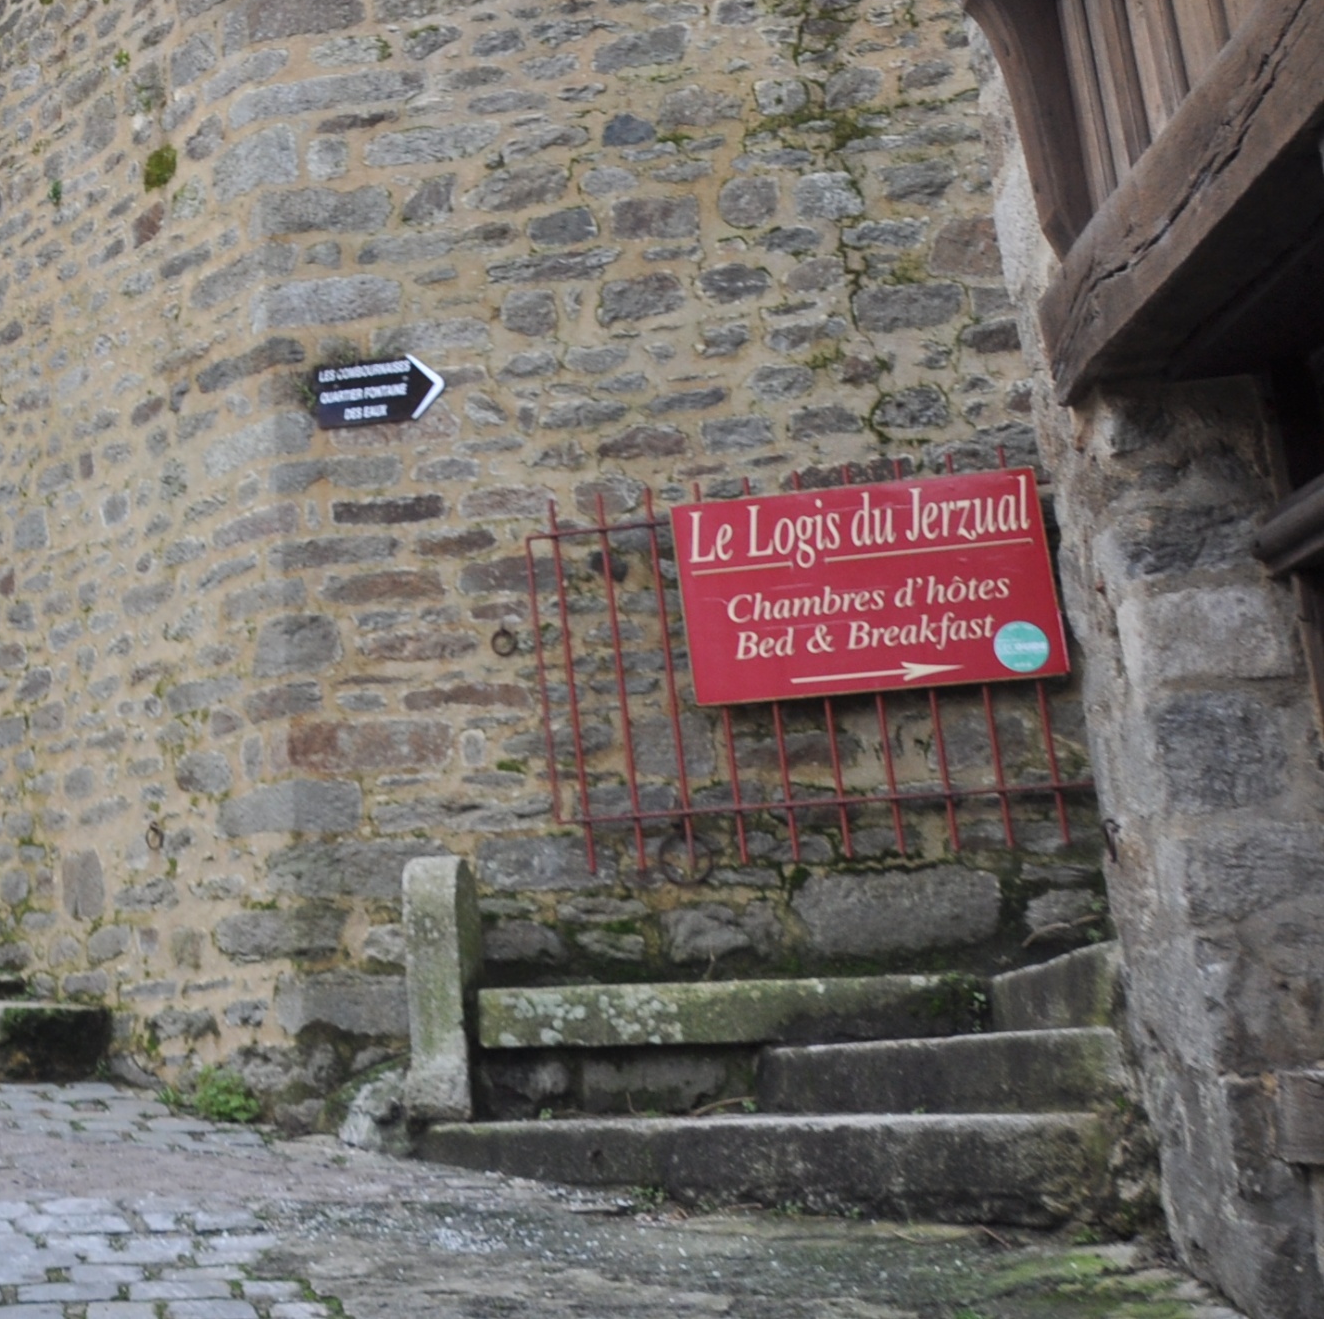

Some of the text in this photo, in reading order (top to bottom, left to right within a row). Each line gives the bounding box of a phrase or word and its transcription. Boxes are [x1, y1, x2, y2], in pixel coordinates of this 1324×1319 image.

[318, 369, 336, 382] LES
[320, 383, 408, 404] QUARTIER FONTAINE
[343, 404, 387, 421] DES EAUX
[689, 475, 1031, 568] Le Logis du Jerzual
[726, 585, 885, 624] Chambres
[735, 627, 795, 660] Bed
[806, 624, 835, 654] &
[847, 613, 996, 651] Breakfast
